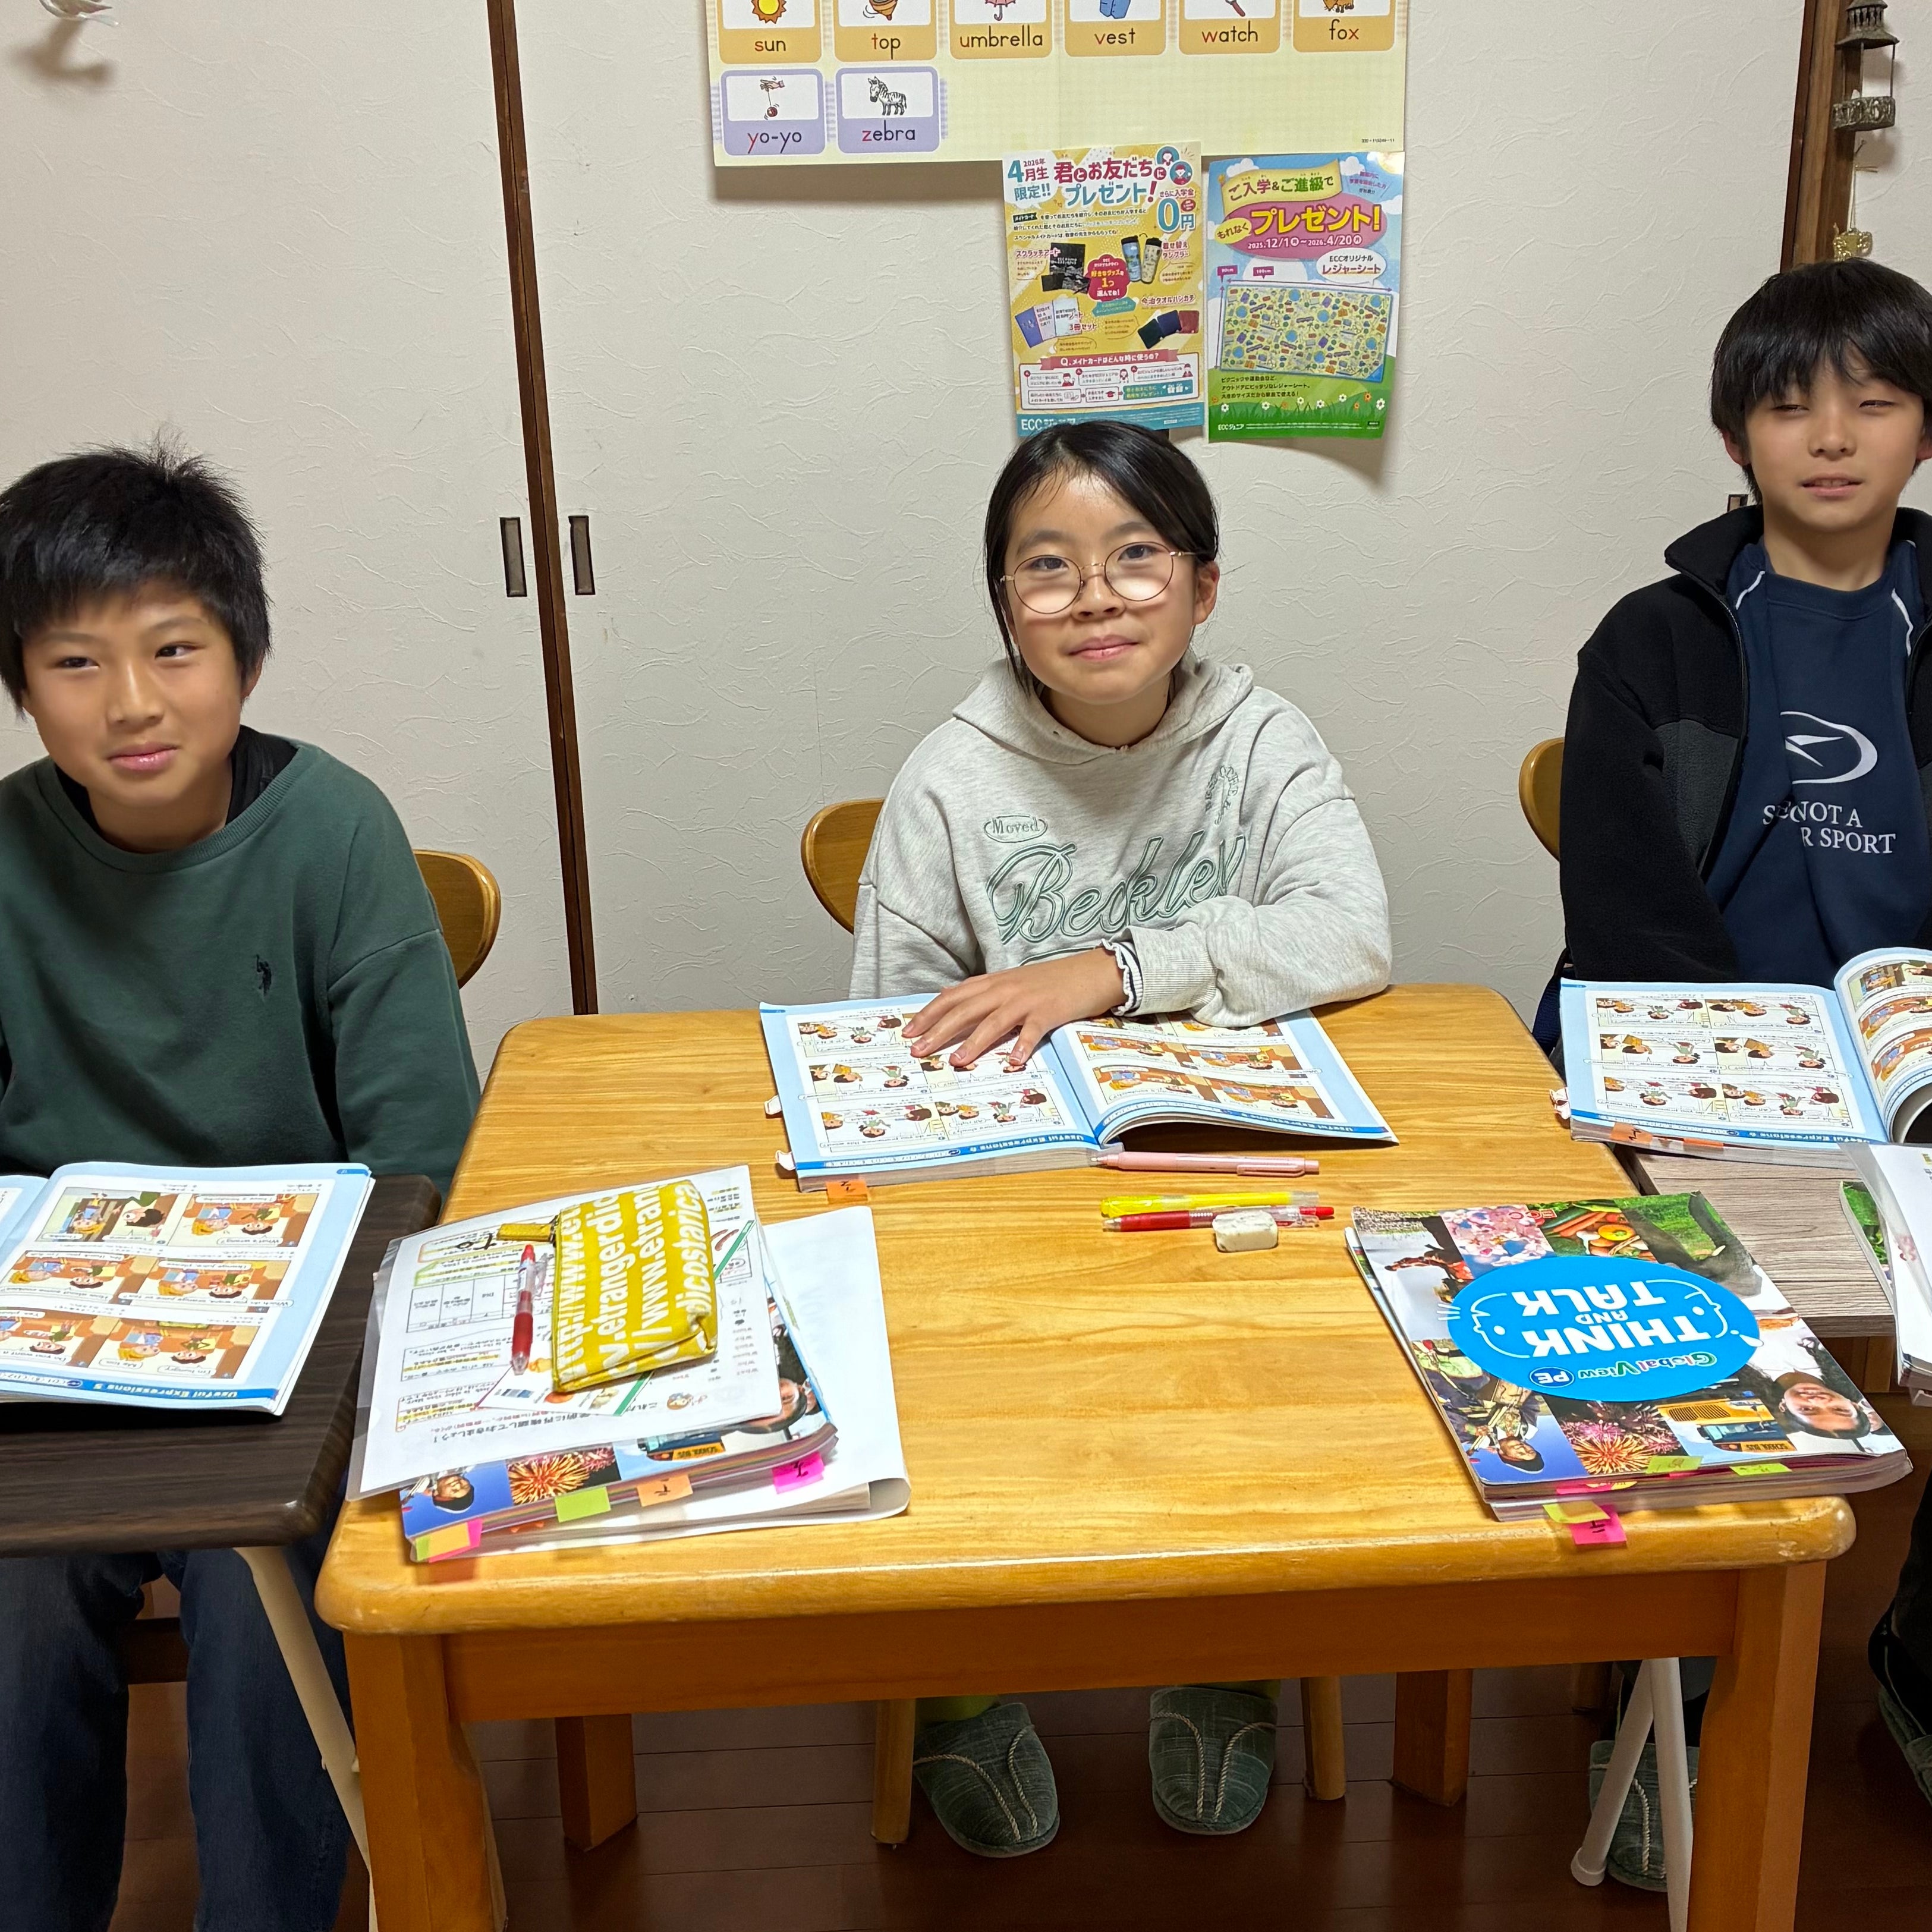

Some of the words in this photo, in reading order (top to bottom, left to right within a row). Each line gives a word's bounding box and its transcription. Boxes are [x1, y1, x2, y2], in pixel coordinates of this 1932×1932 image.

[959, 24, 1043, 48] umbrella
[1094, 27, 1136, 45] vest
[1201, 22, 1259, 43] watch
[1329, 20, 1360, 40] fox
[754, 40, 787, 52] sun
[871, 33, 901, 60] top
[862, 121, 916, 141] zebra
[747, 131, 803, 154] yo-yo
[1053, 157, 1167, 184] 君とお友だちに
[1014, 182, 1051, 202] 限定!!
[1065, 180, 1157, 206] プレゼント!
[1228, 176, 1334, 201] ご入学&ご進級で
[1251, 205, 1381, 235] プレゼント!
[1217, 222, 1249, 239] もれなく
[1322, 264, 1382, 275] レジャーシート
[991, 817, 1040, 834] Moved
[1820, 827, 1896, 854] SPORT
[1317, 1124, 1354, 1133] Useful
[1760, 1131, 1830, 1142] Expressions
[979, 1137, 1046, 1151] Expressions
[668, 1184, 713, 1316] dicostarica
[1511, 1279, 1666, 1317] TALK
[1575, 1310, 1629, 1326] AND
[1521, 1316, 1711, 1358] THINK
[1577, 1359, 1638, 1382] View
[1639, 1351, 1717, 1373] Global
[1533, 1370, 1568, 1385] PE
[106, 1383, 190, 1399] Expressions
[193, 1390, 238, 1399] Useful
